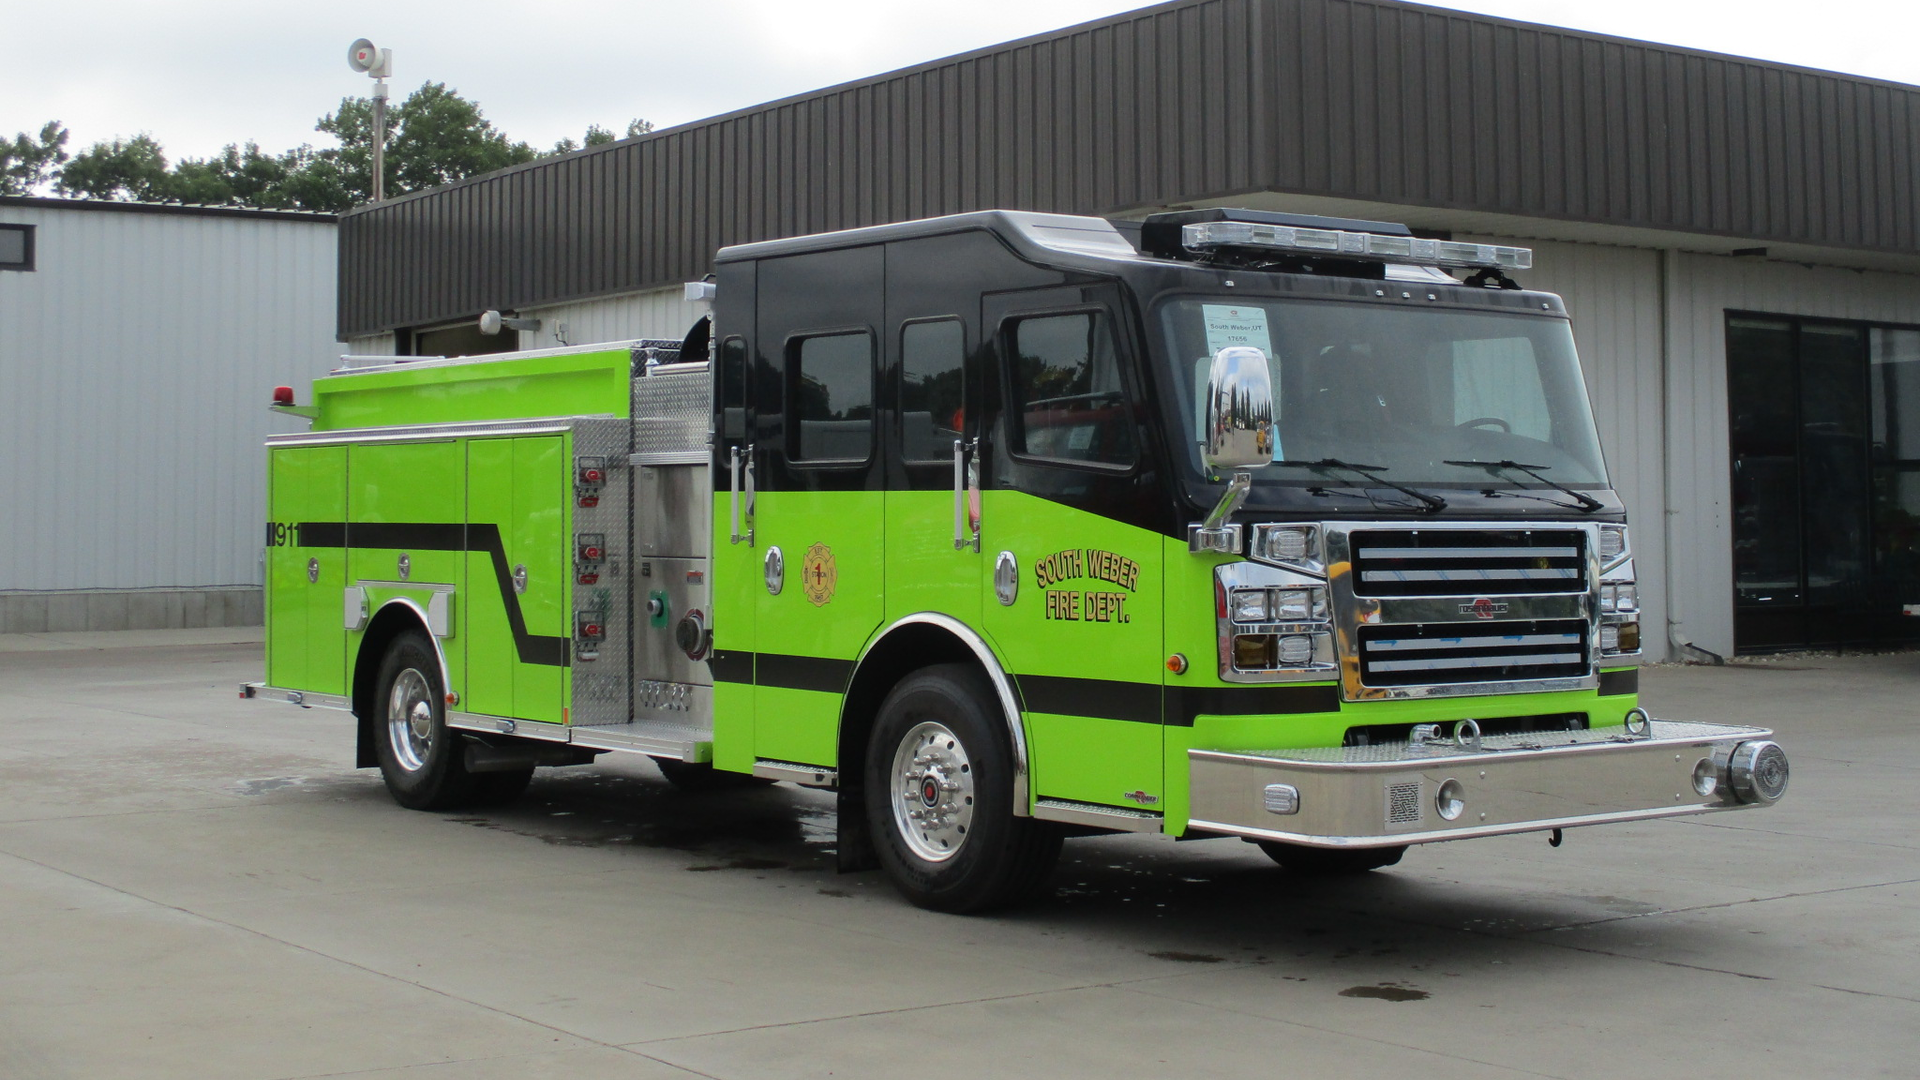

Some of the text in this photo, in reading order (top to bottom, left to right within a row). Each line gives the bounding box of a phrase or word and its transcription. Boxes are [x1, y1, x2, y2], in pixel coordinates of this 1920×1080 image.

[276, 523, 300, 547] 911
[1035, 549, 1140, 592] SOUTH WEBER
[1046, 590, 1130, 623] FIRE DEPT.
